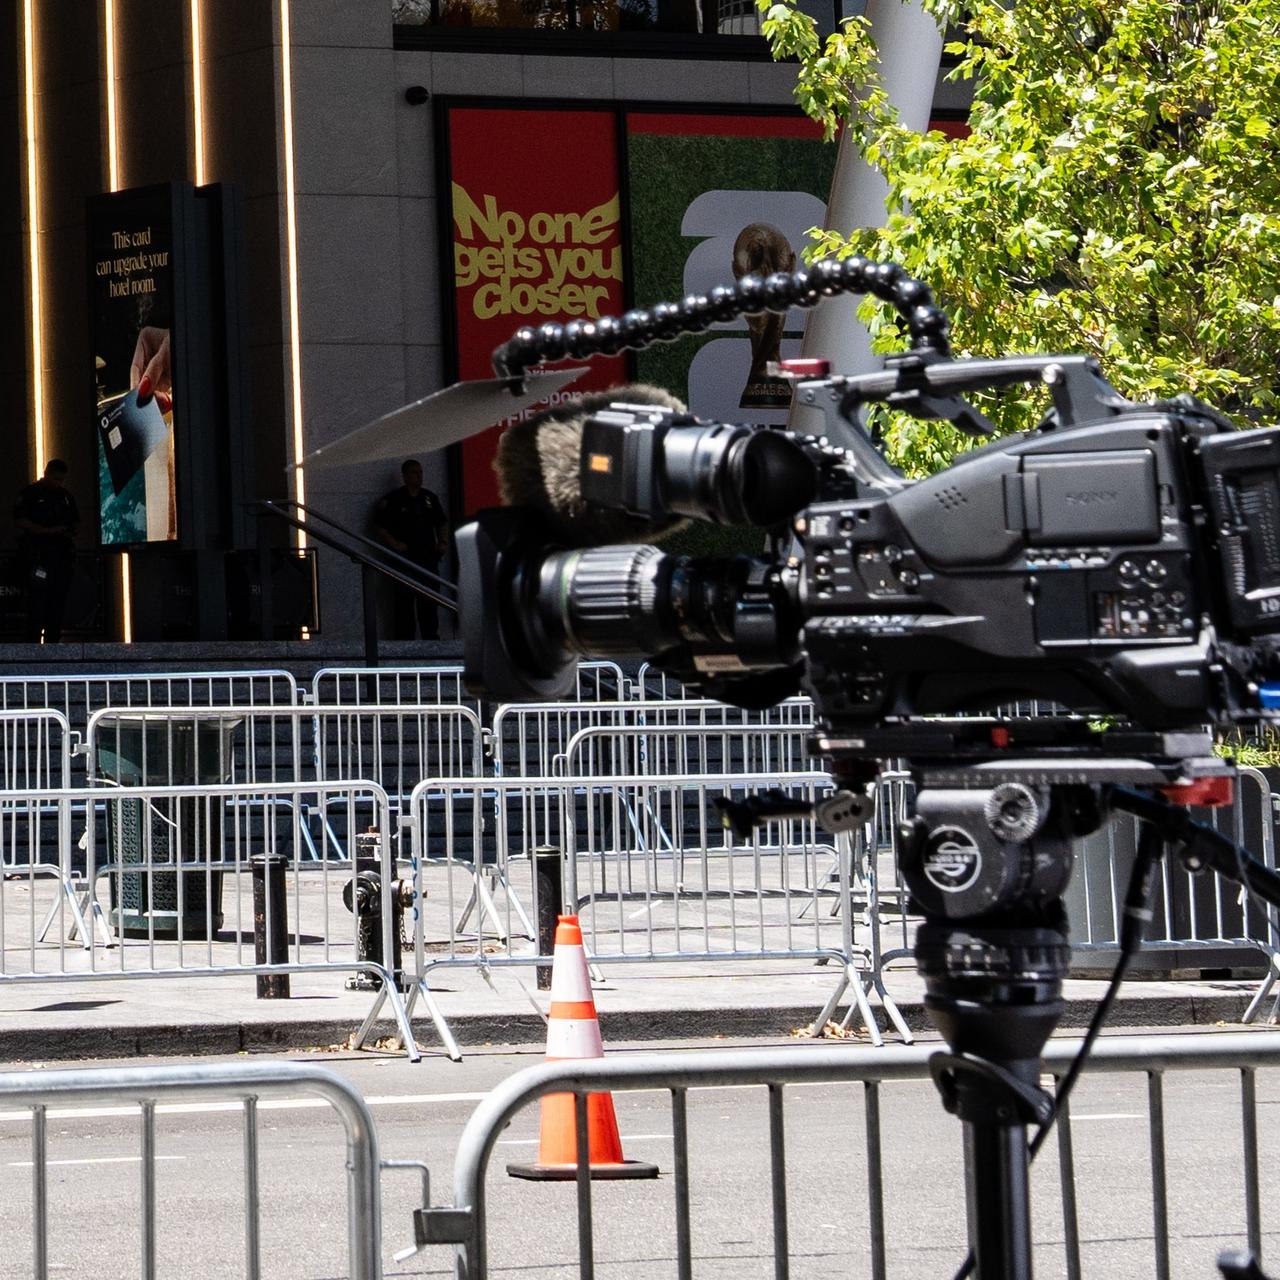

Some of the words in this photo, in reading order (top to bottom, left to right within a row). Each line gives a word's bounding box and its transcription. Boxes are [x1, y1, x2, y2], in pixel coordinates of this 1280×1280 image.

[451, 180, 526, 244] No
[528, 189, 621, 245] one
[111, 229, 131, 250] This
[132, 225, 151, 247] card
[96, 260, 111, 276] can
[113, 251, 147, 277] upgrade
[149, 251, 169, 272] your
[453, 240, 543, 288] gets
[543, 244, 624, 288] you
[109, 277, 130, 298] hotel
[131, 277, 157, 296] room.
[472, 276, 610, 320] closer
